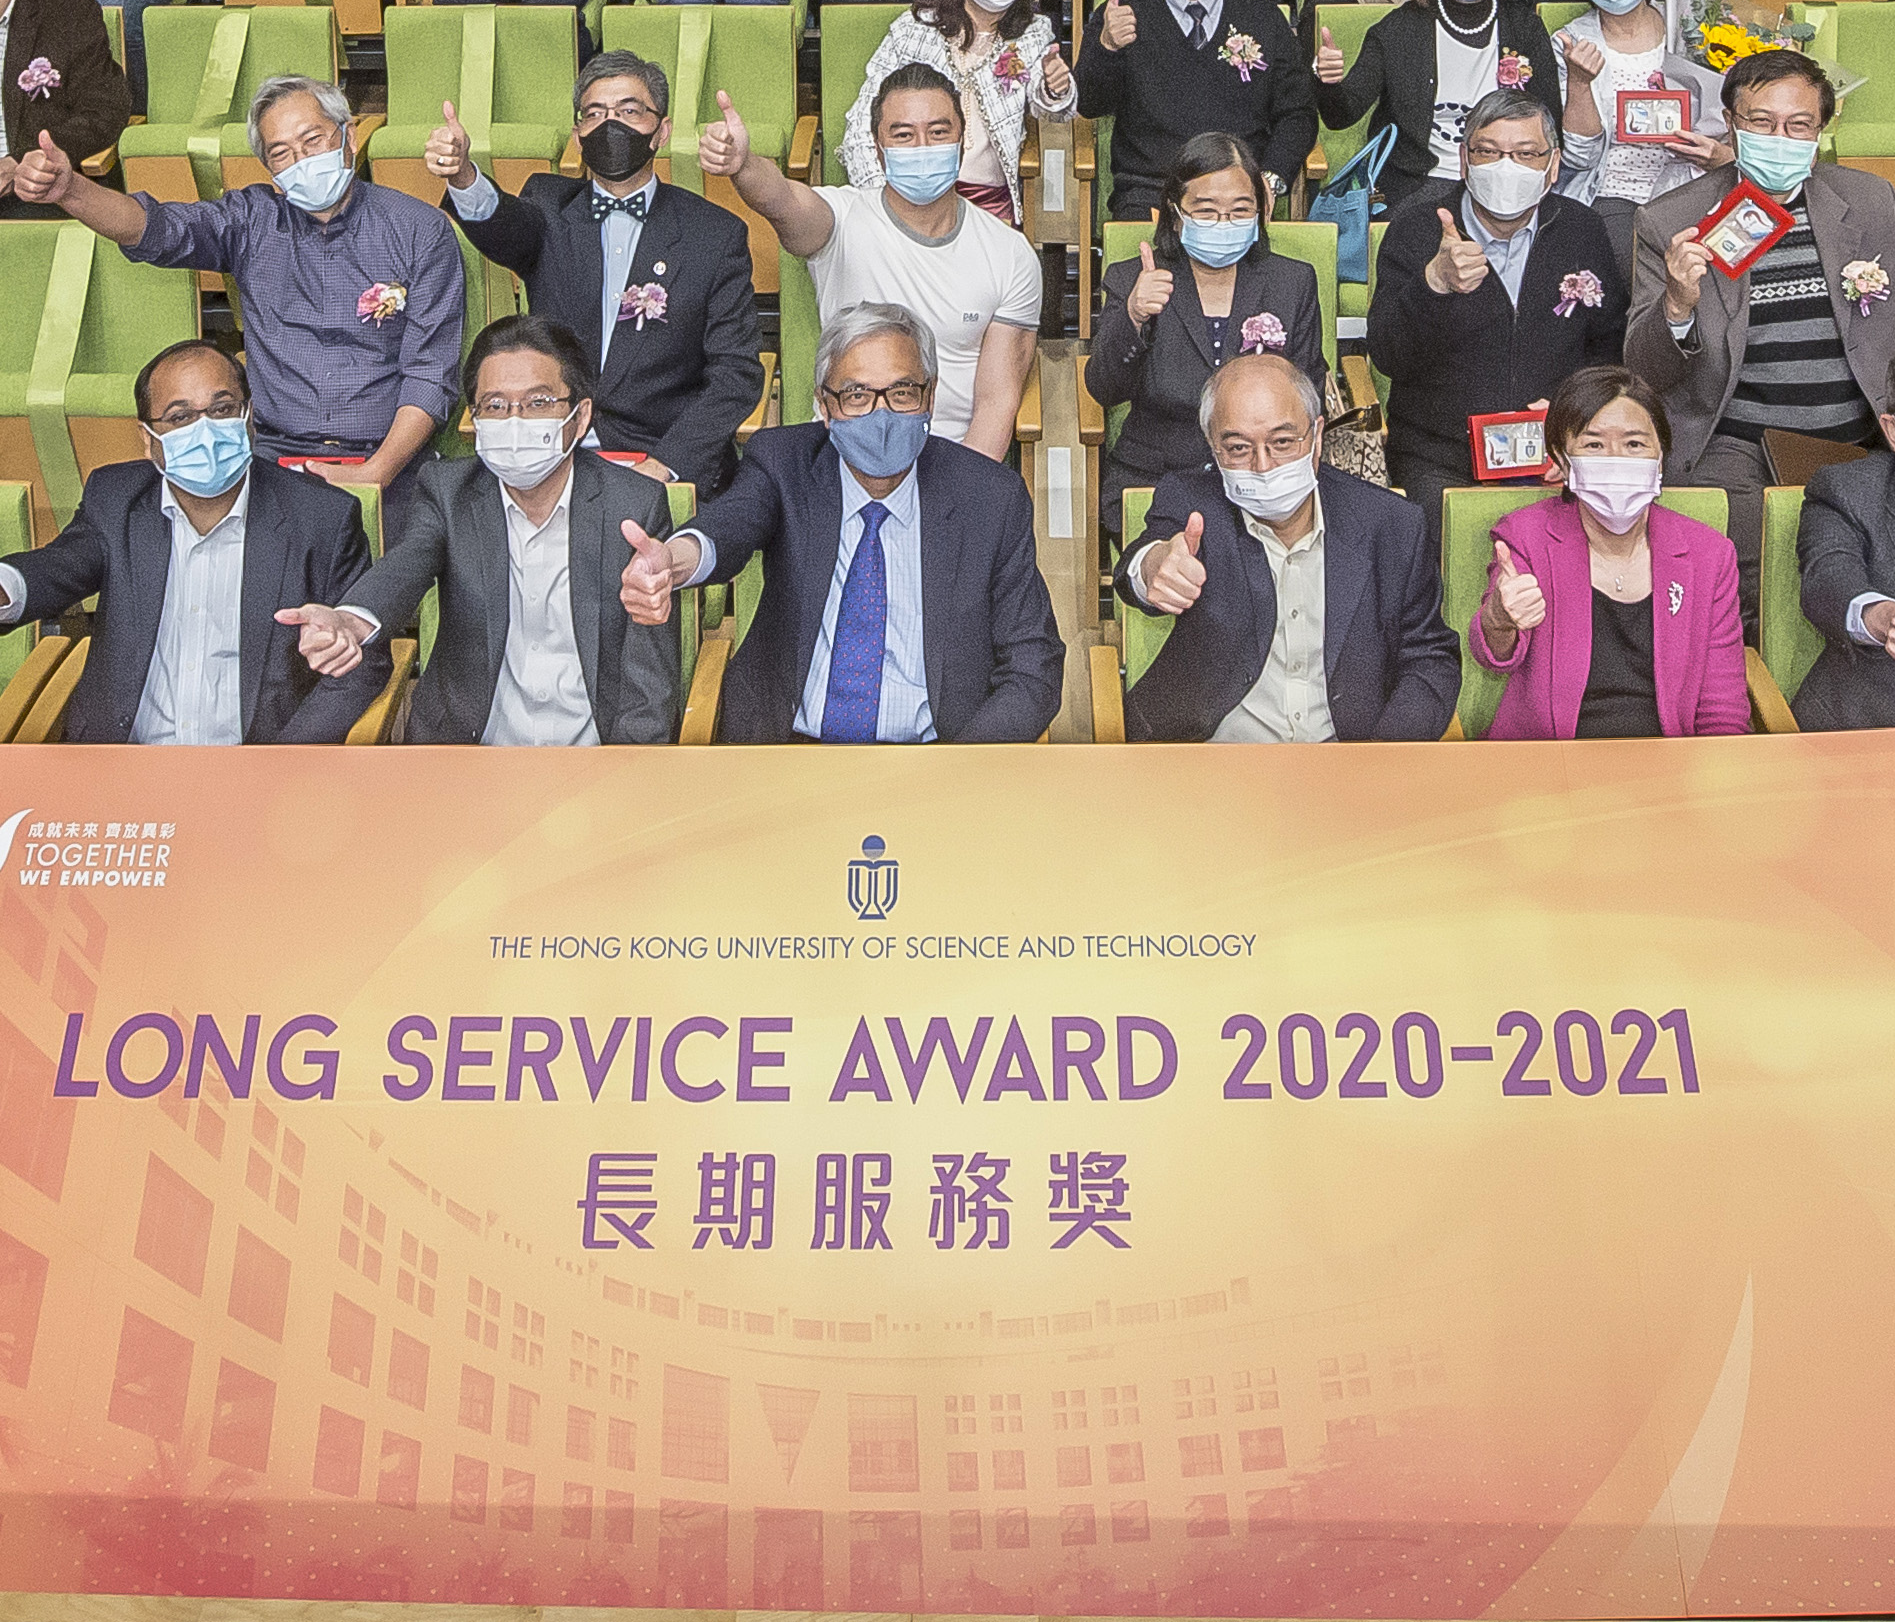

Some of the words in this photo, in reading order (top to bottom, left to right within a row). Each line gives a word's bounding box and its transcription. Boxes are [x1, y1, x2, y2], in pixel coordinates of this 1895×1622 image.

[28, 822, 99, 839] 成就未來
[105, 822, 177, 840] 齊放異彩
[24, 843, 171, 868] TOGETHER
[19, 871, 51, 886] WE
[60, 871, 167, 887] EMPOWER
[490, 936, 533, 959] THE
[541, 936, 622, 959] HONG
[630, 936, 708, 959] KONG
[717, 936, 856, 959] UNIVERSITY
[863, 936, 898, 959] OF
[906, 936, 1010, 959] SCIENCE
[1018, 935, 1076, 958] AND
[1083, 934, 1258, 958] TECHNOLOGY
[54, 1013, 341, 1101] LONG
[384, 1014, 794, 1103] SERVICE
[831, 1015, 1178, 1103] AWARD
[1223, 1010, 1700, 1100] 2020-2021
[578, 1153, 1132, 1250] 長期服務獎
